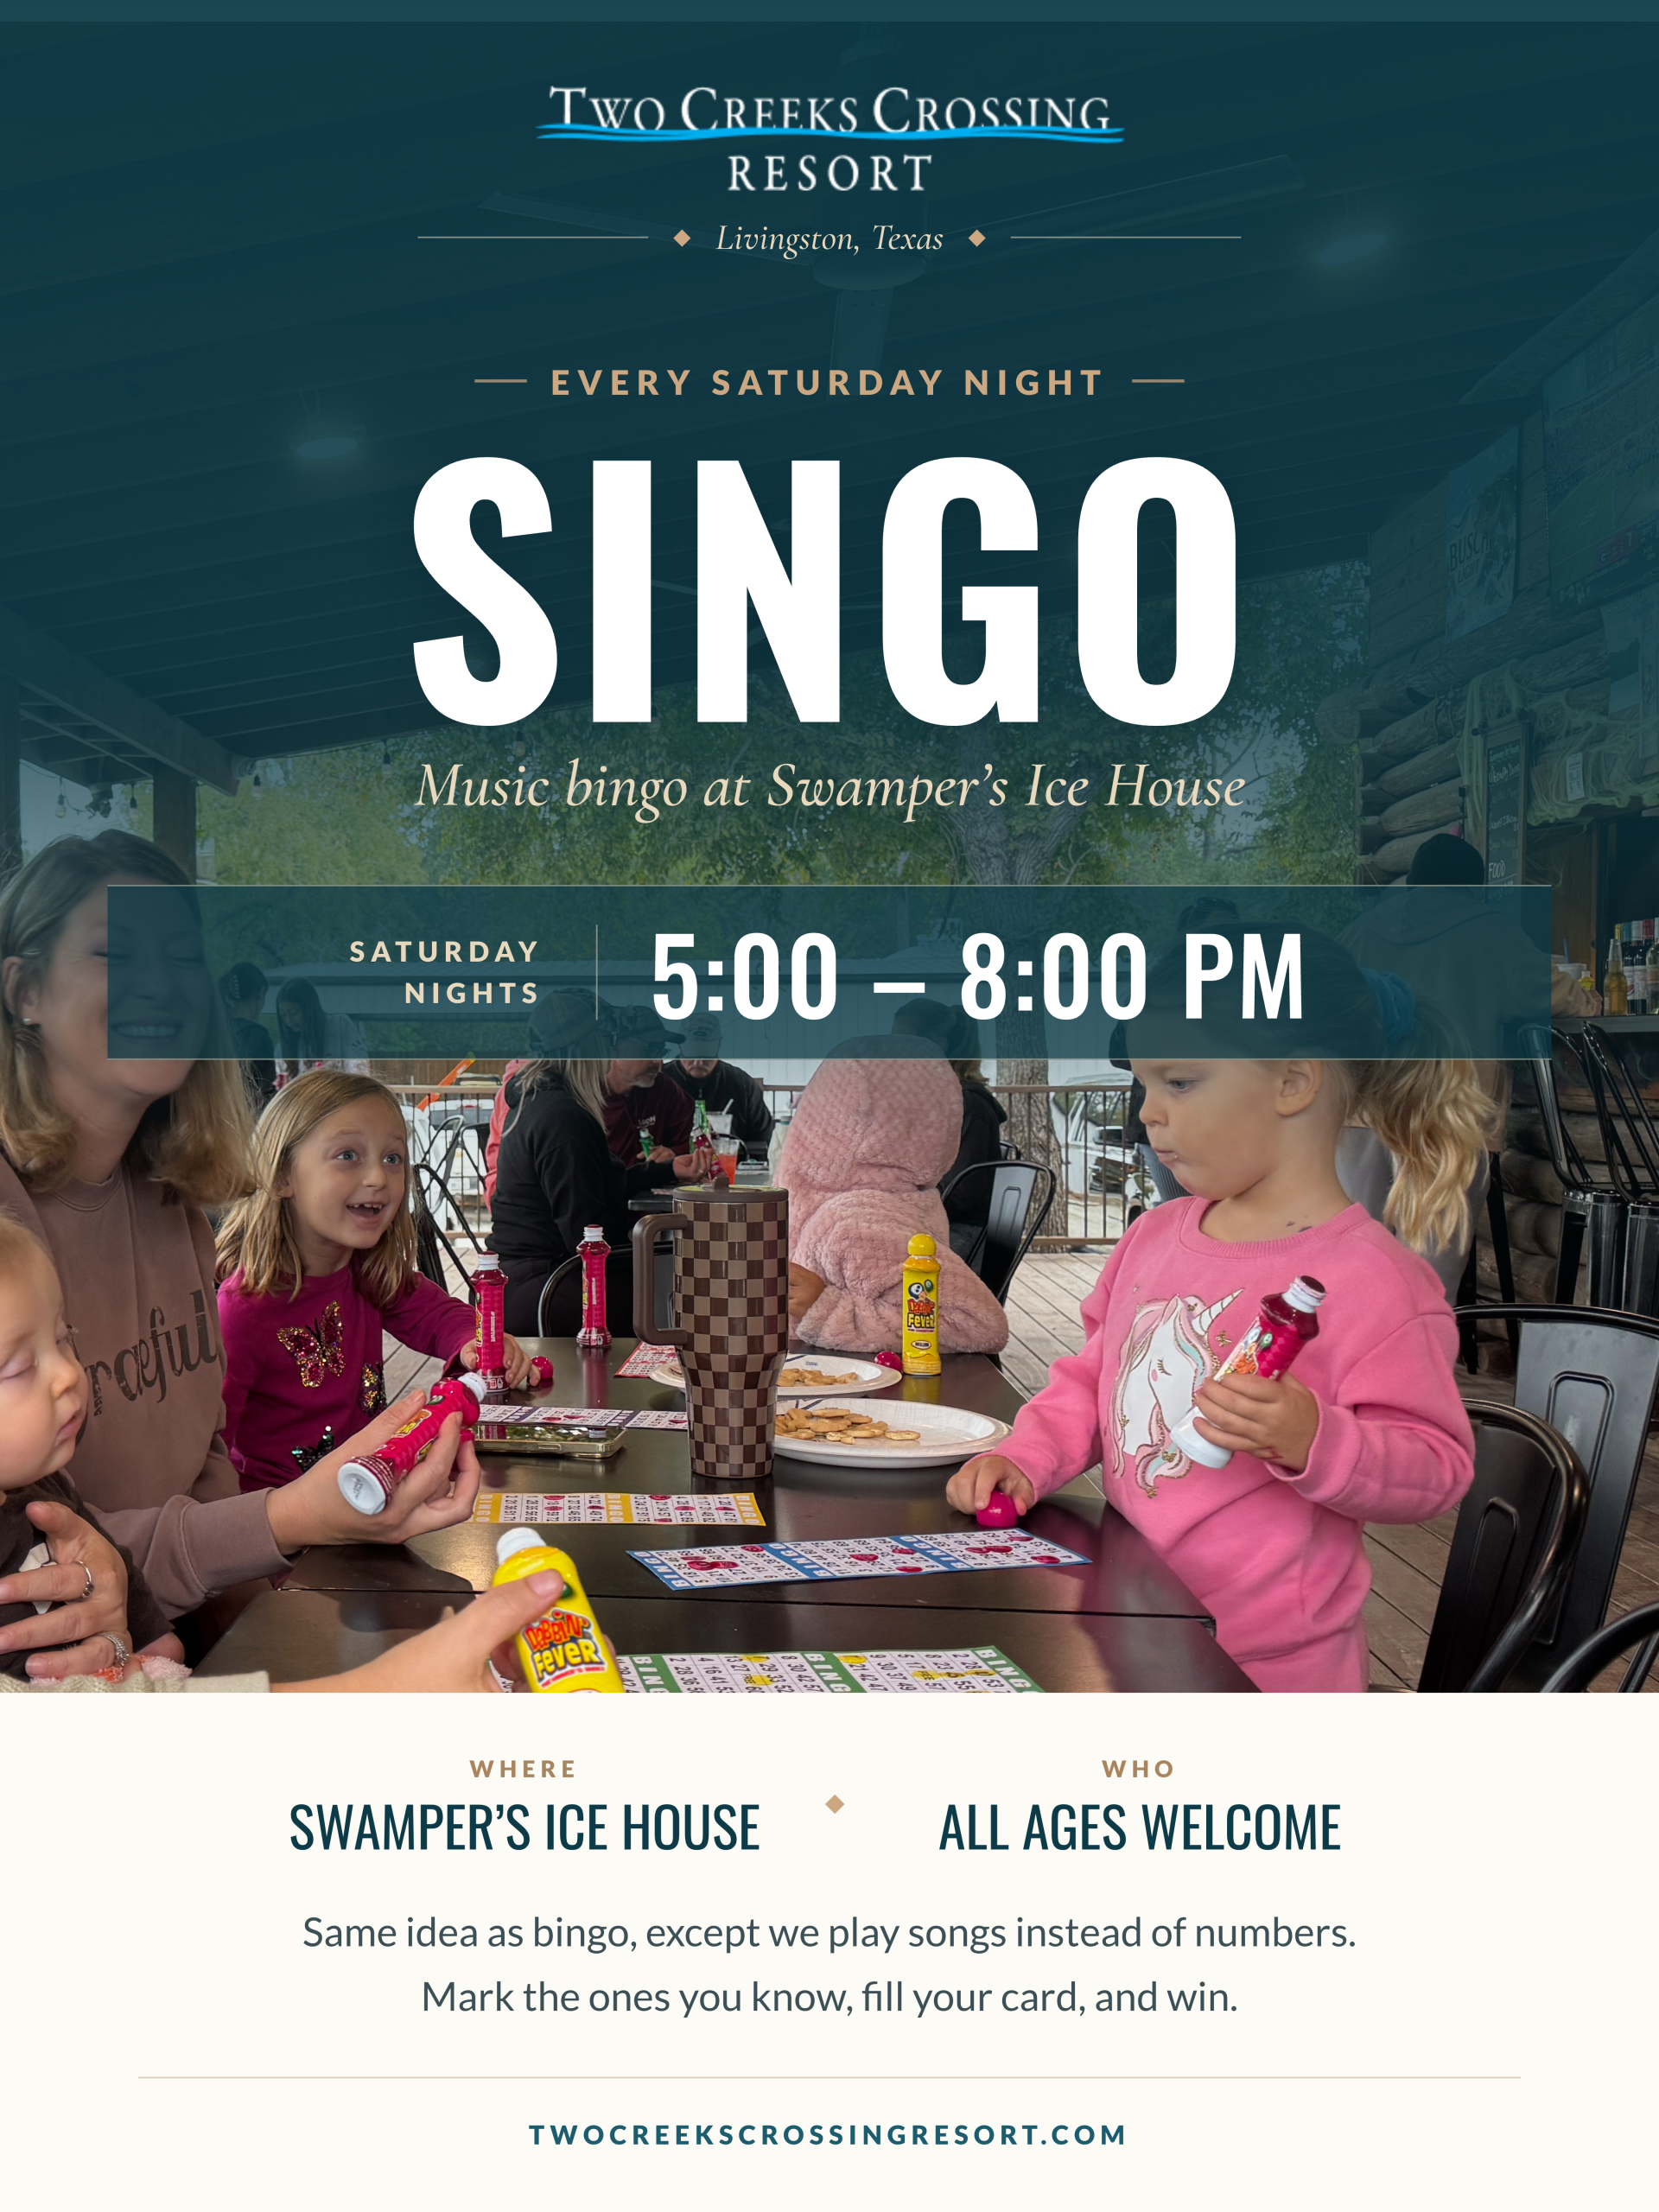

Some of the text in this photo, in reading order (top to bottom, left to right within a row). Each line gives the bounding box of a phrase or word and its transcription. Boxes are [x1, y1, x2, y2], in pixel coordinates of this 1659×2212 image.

[1449, 531, 1491, 572] BUSCH
[1458, 558, 1481, 583] LIGHT
[899, 1535, 970, 1569] BINGO
[769, 1543, 834, 1576] BINGO
[634, 1551, 691, 1587] BINGO
[673, 1666, 694, 1675] 28
[703, 1666, 722, 1675] 16
[730, 1663, 751, 1672] 27
[759, 1663, 779, 1672] 29
[787, 1663, 808, 1672] 30
[877, 1662, 898, 1671] 30
[975, 1649, 1039, 1693] BING
[766, 1674, 787, 1683] 33
[796, 1674, 816, 1682] 42
[848, 1663, 888, 1692] 21 42 47
[887, 1672, 908, 1681] 37
[932, 1662, 955, 1670] 23
[953, 1681, 976, 1690] 55
[960, 1661, 982, 1669] 28
[982, 1678, 1005, 1688] 53
[679, 1677, 700, 1686] 36
[774, 1684, 795, 1693] 52
[804, 1684, 825, 1693] 57
[897, 1682, 918, 1691] 49
[925, 1682, 947, 1691] 57
